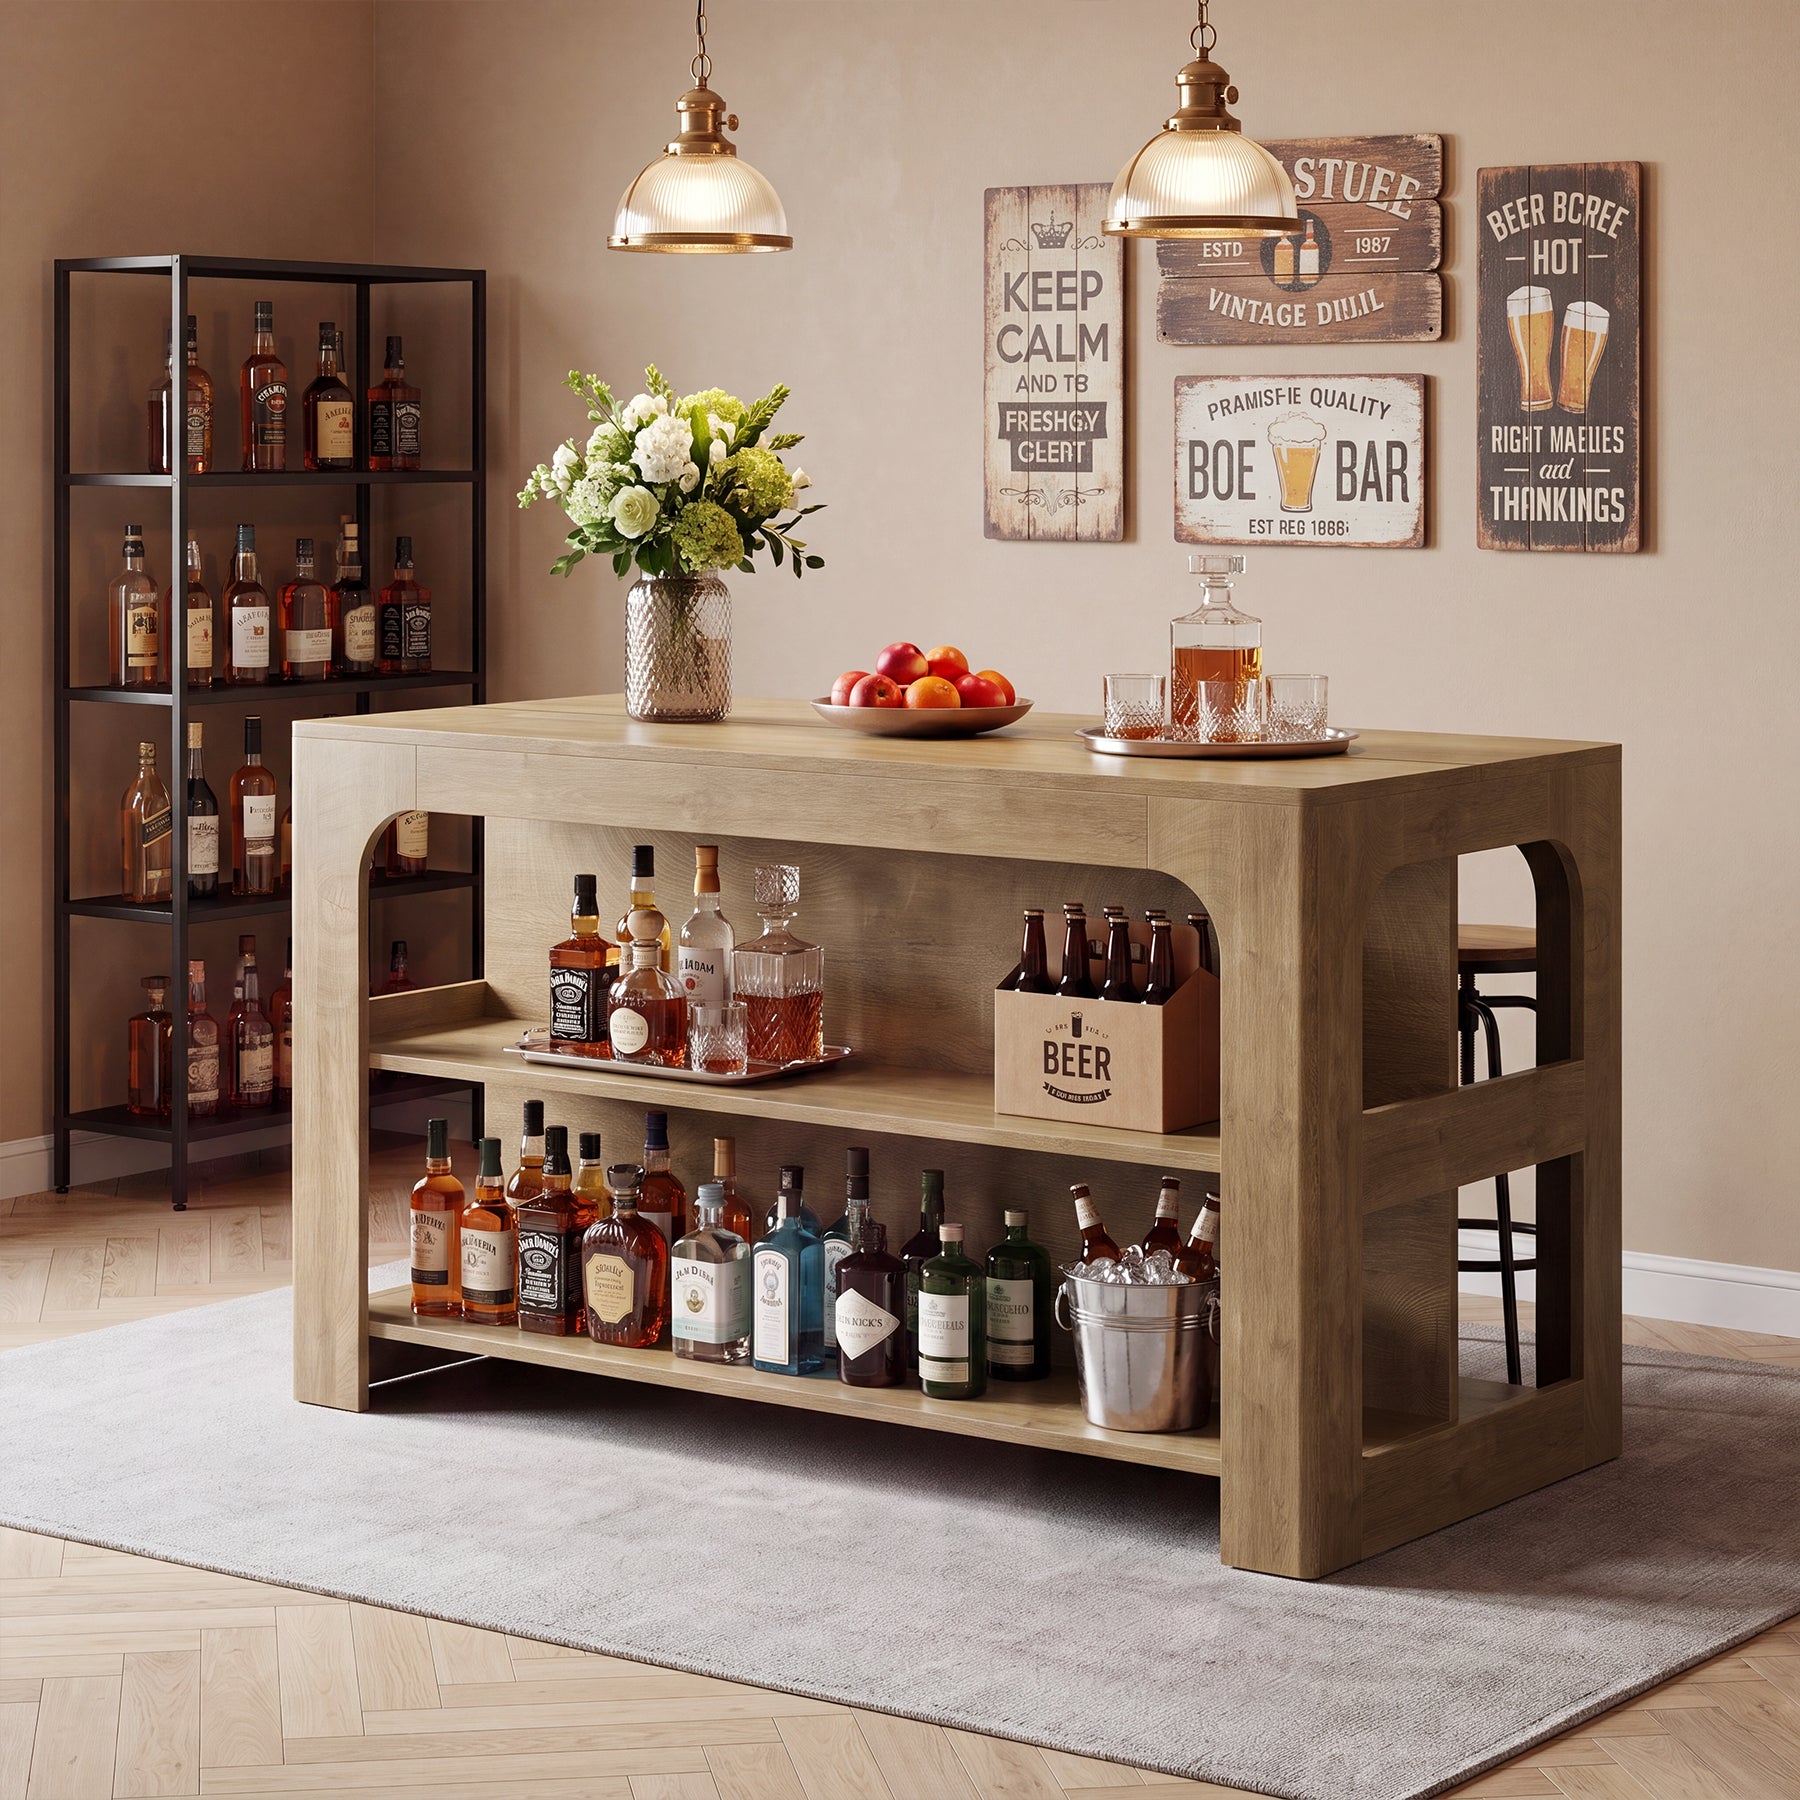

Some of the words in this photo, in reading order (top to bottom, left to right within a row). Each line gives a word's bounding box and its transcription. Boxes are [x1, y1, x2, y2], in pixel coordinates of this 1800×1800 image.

[1486, 194, 1546, 242] BEER
[1203, 242, 1242, 257] ESTD
[1356, 237, 1390, 254] 1987
[1533, 238, 1582, 275] HOT
[1004, 270, 1103, 312] KEEP
[1208, 288, 1306, 327] VINTAGE
[996, 323, 1109, 363] CALM
[1016, 374, 1058, 393] AND
[1310, 387, 1392, 420] QUALITY
[1491, 425, 1544, 453] RIGHT
[1188, 439, 1256, 501] BOE
[1336, 440, 1410, 503] BAR
[1489, 486, 1626, 523] THANKINGS
[1249, 519, 1274, 534] EST
[1279, 520, 1305, 536] REG
[1043, 1040, 1112, 1081] BEER
